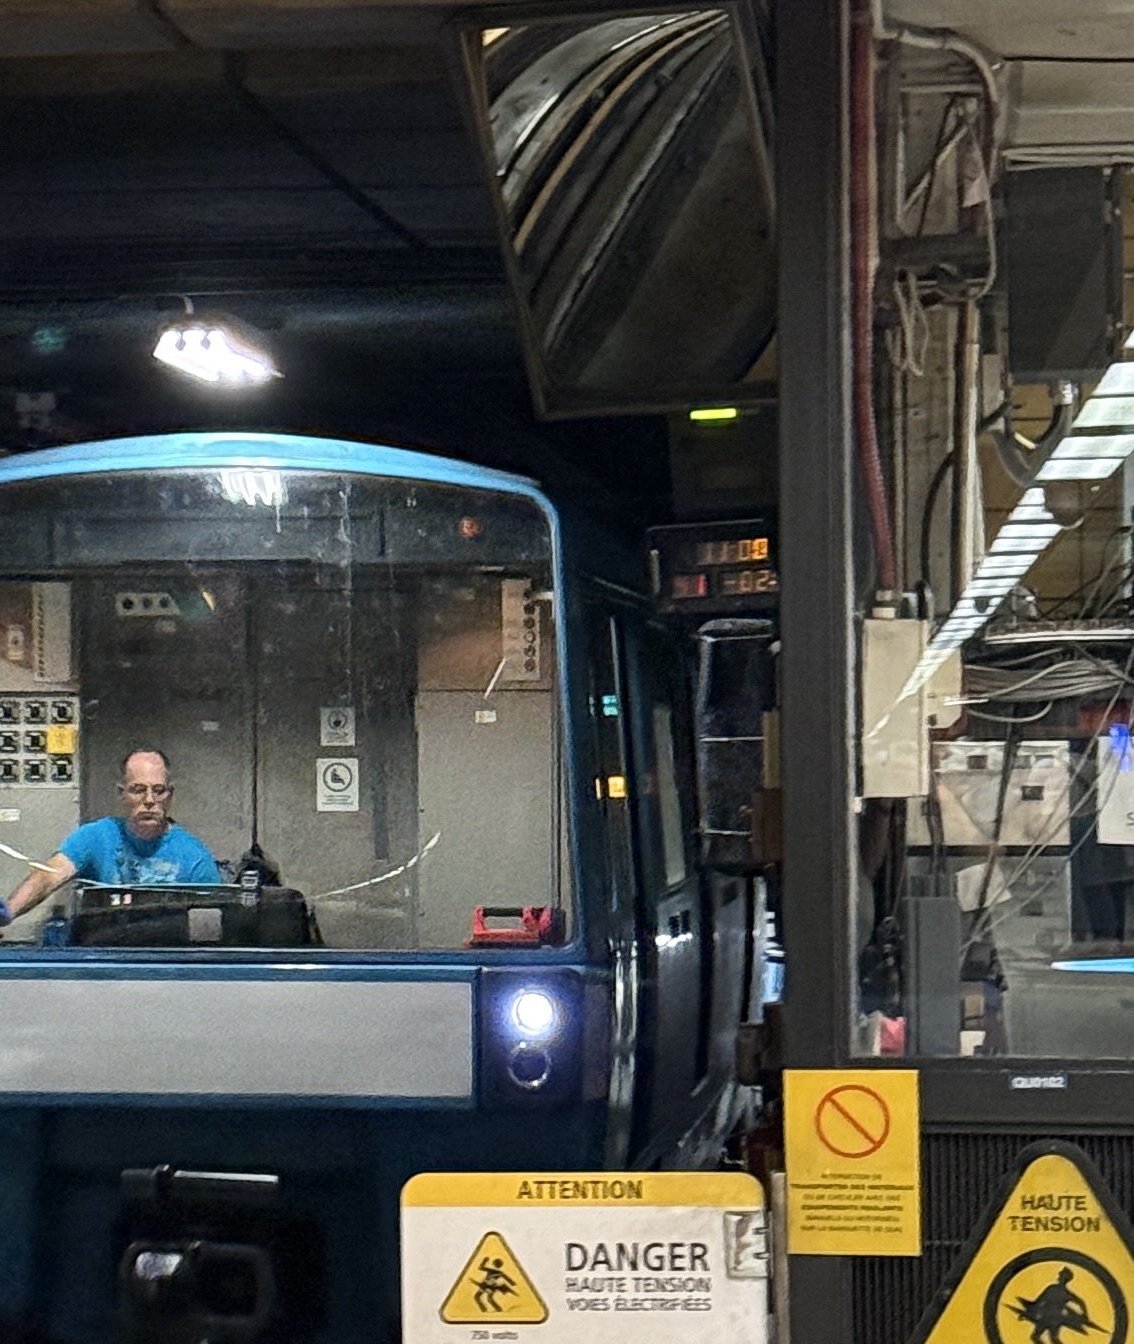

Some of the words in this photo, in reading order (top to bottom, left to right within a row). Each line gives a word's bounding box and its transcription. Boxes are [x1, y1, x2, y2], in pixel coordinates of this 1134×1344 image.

[516, 1179, 643, 1200] ATTENTION
[1020, 1194, 1088, 1211] HAUTE
[1007, 1215, 1101, 1233] TENSION
[565, 1242, 711, 1272] DANGER
[565, 1276, 627, 1293] HAUTE
[632, 1277, 712, 1293] TENSION
[566, 1297, 608, 1311] VOIES
